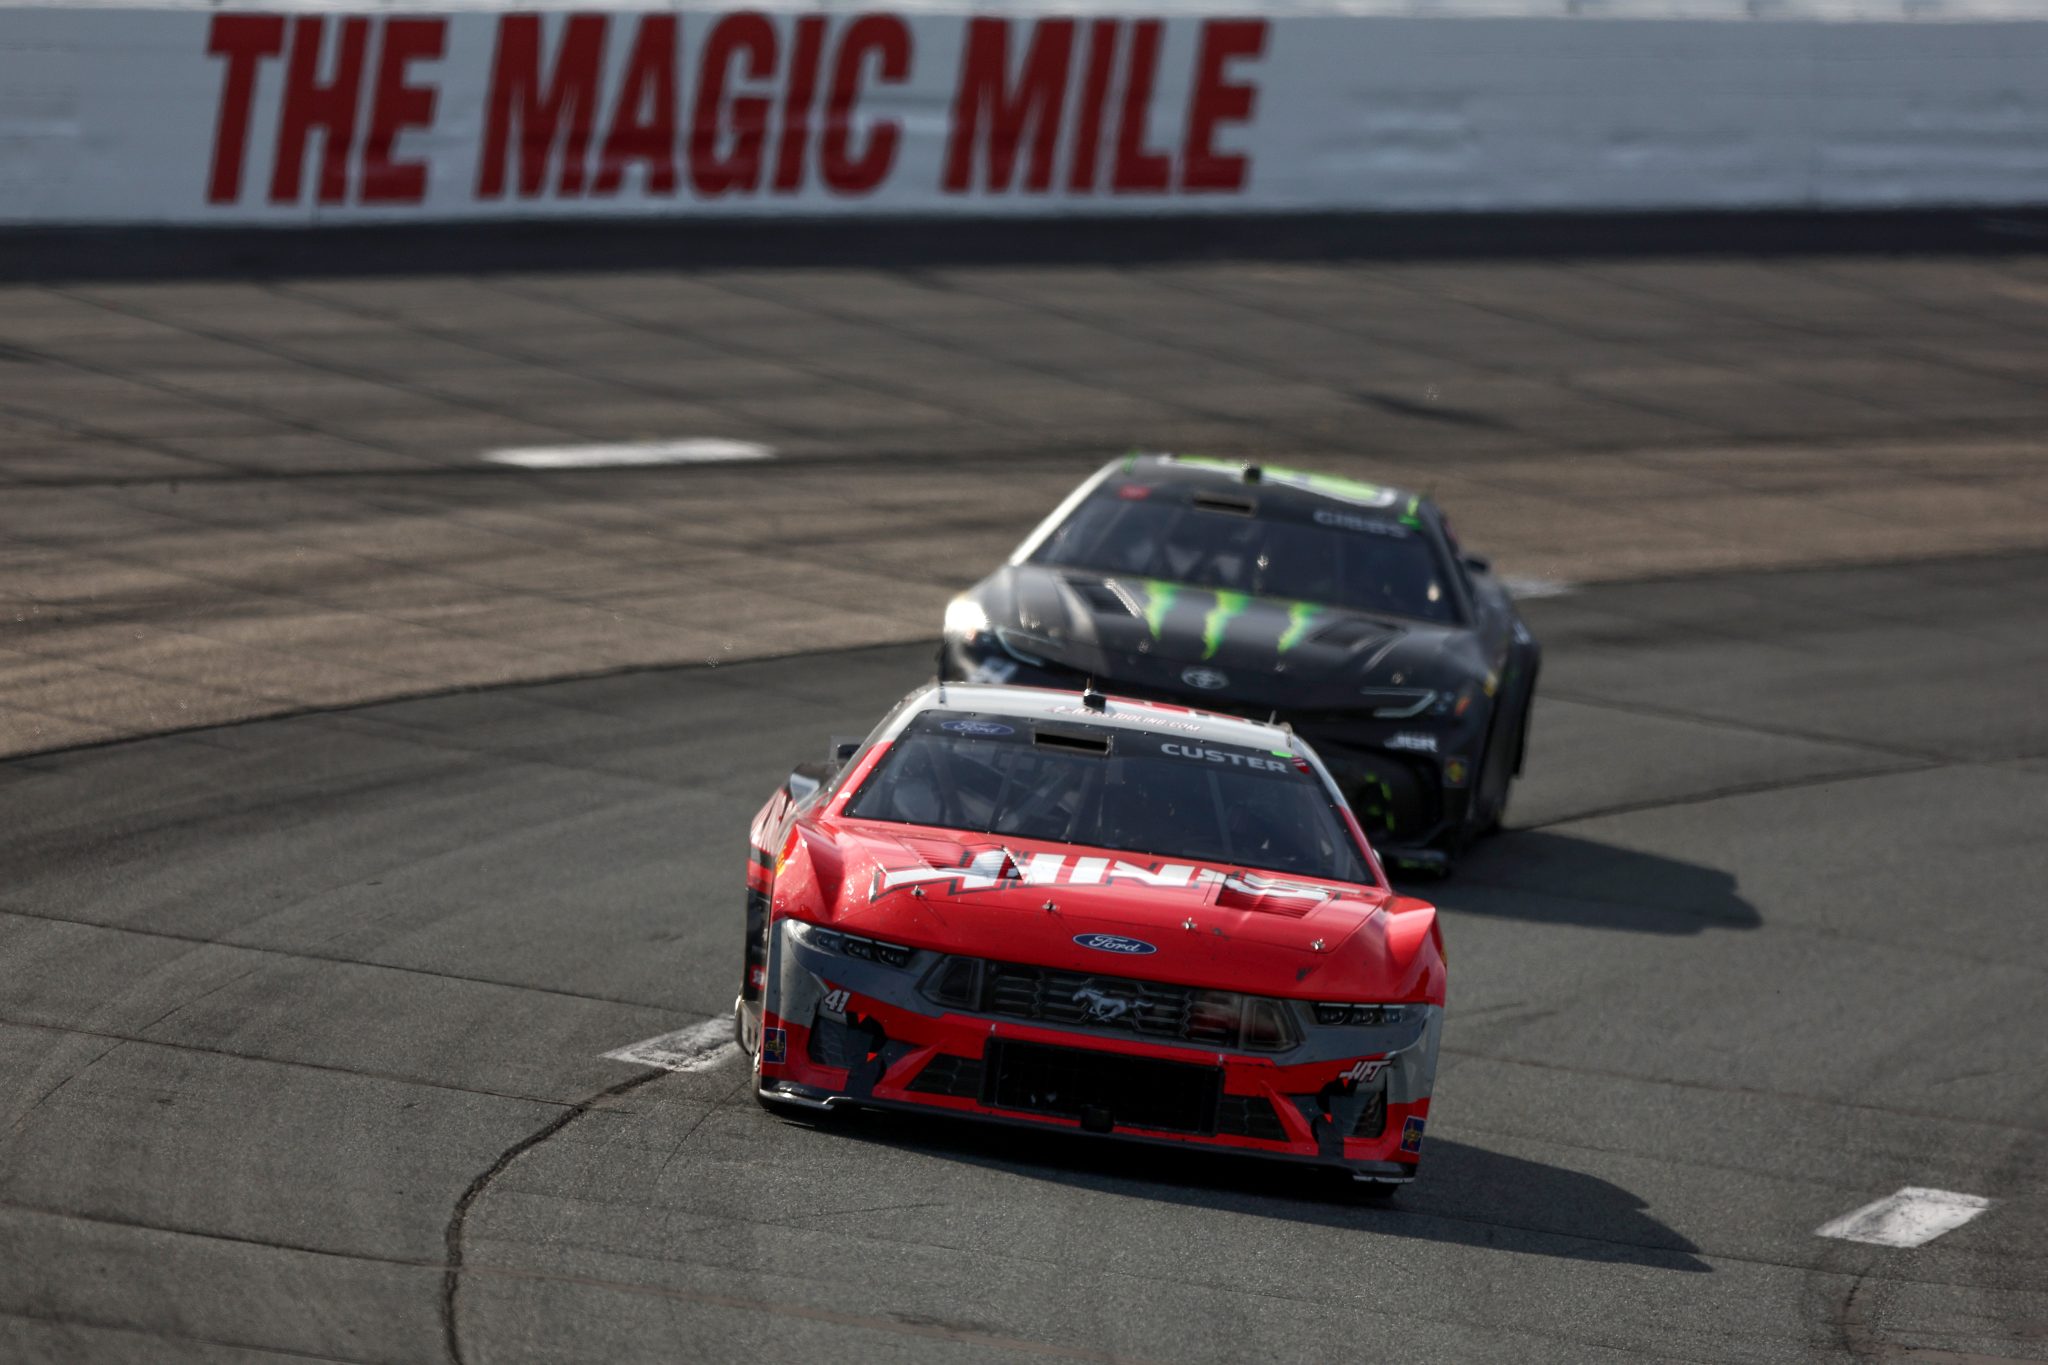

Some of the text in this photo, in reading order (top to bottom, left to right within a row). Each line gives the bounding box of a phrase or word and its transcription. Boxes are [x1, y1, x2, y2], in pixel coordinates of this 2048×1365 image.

[207, 12, 1268, 205] THE MAGIC MILE
[1160, 743, 1289, 774] CUSTER
[1088, 934, 1142, 953] Ford
[824, 989, 851, 1014] 41
